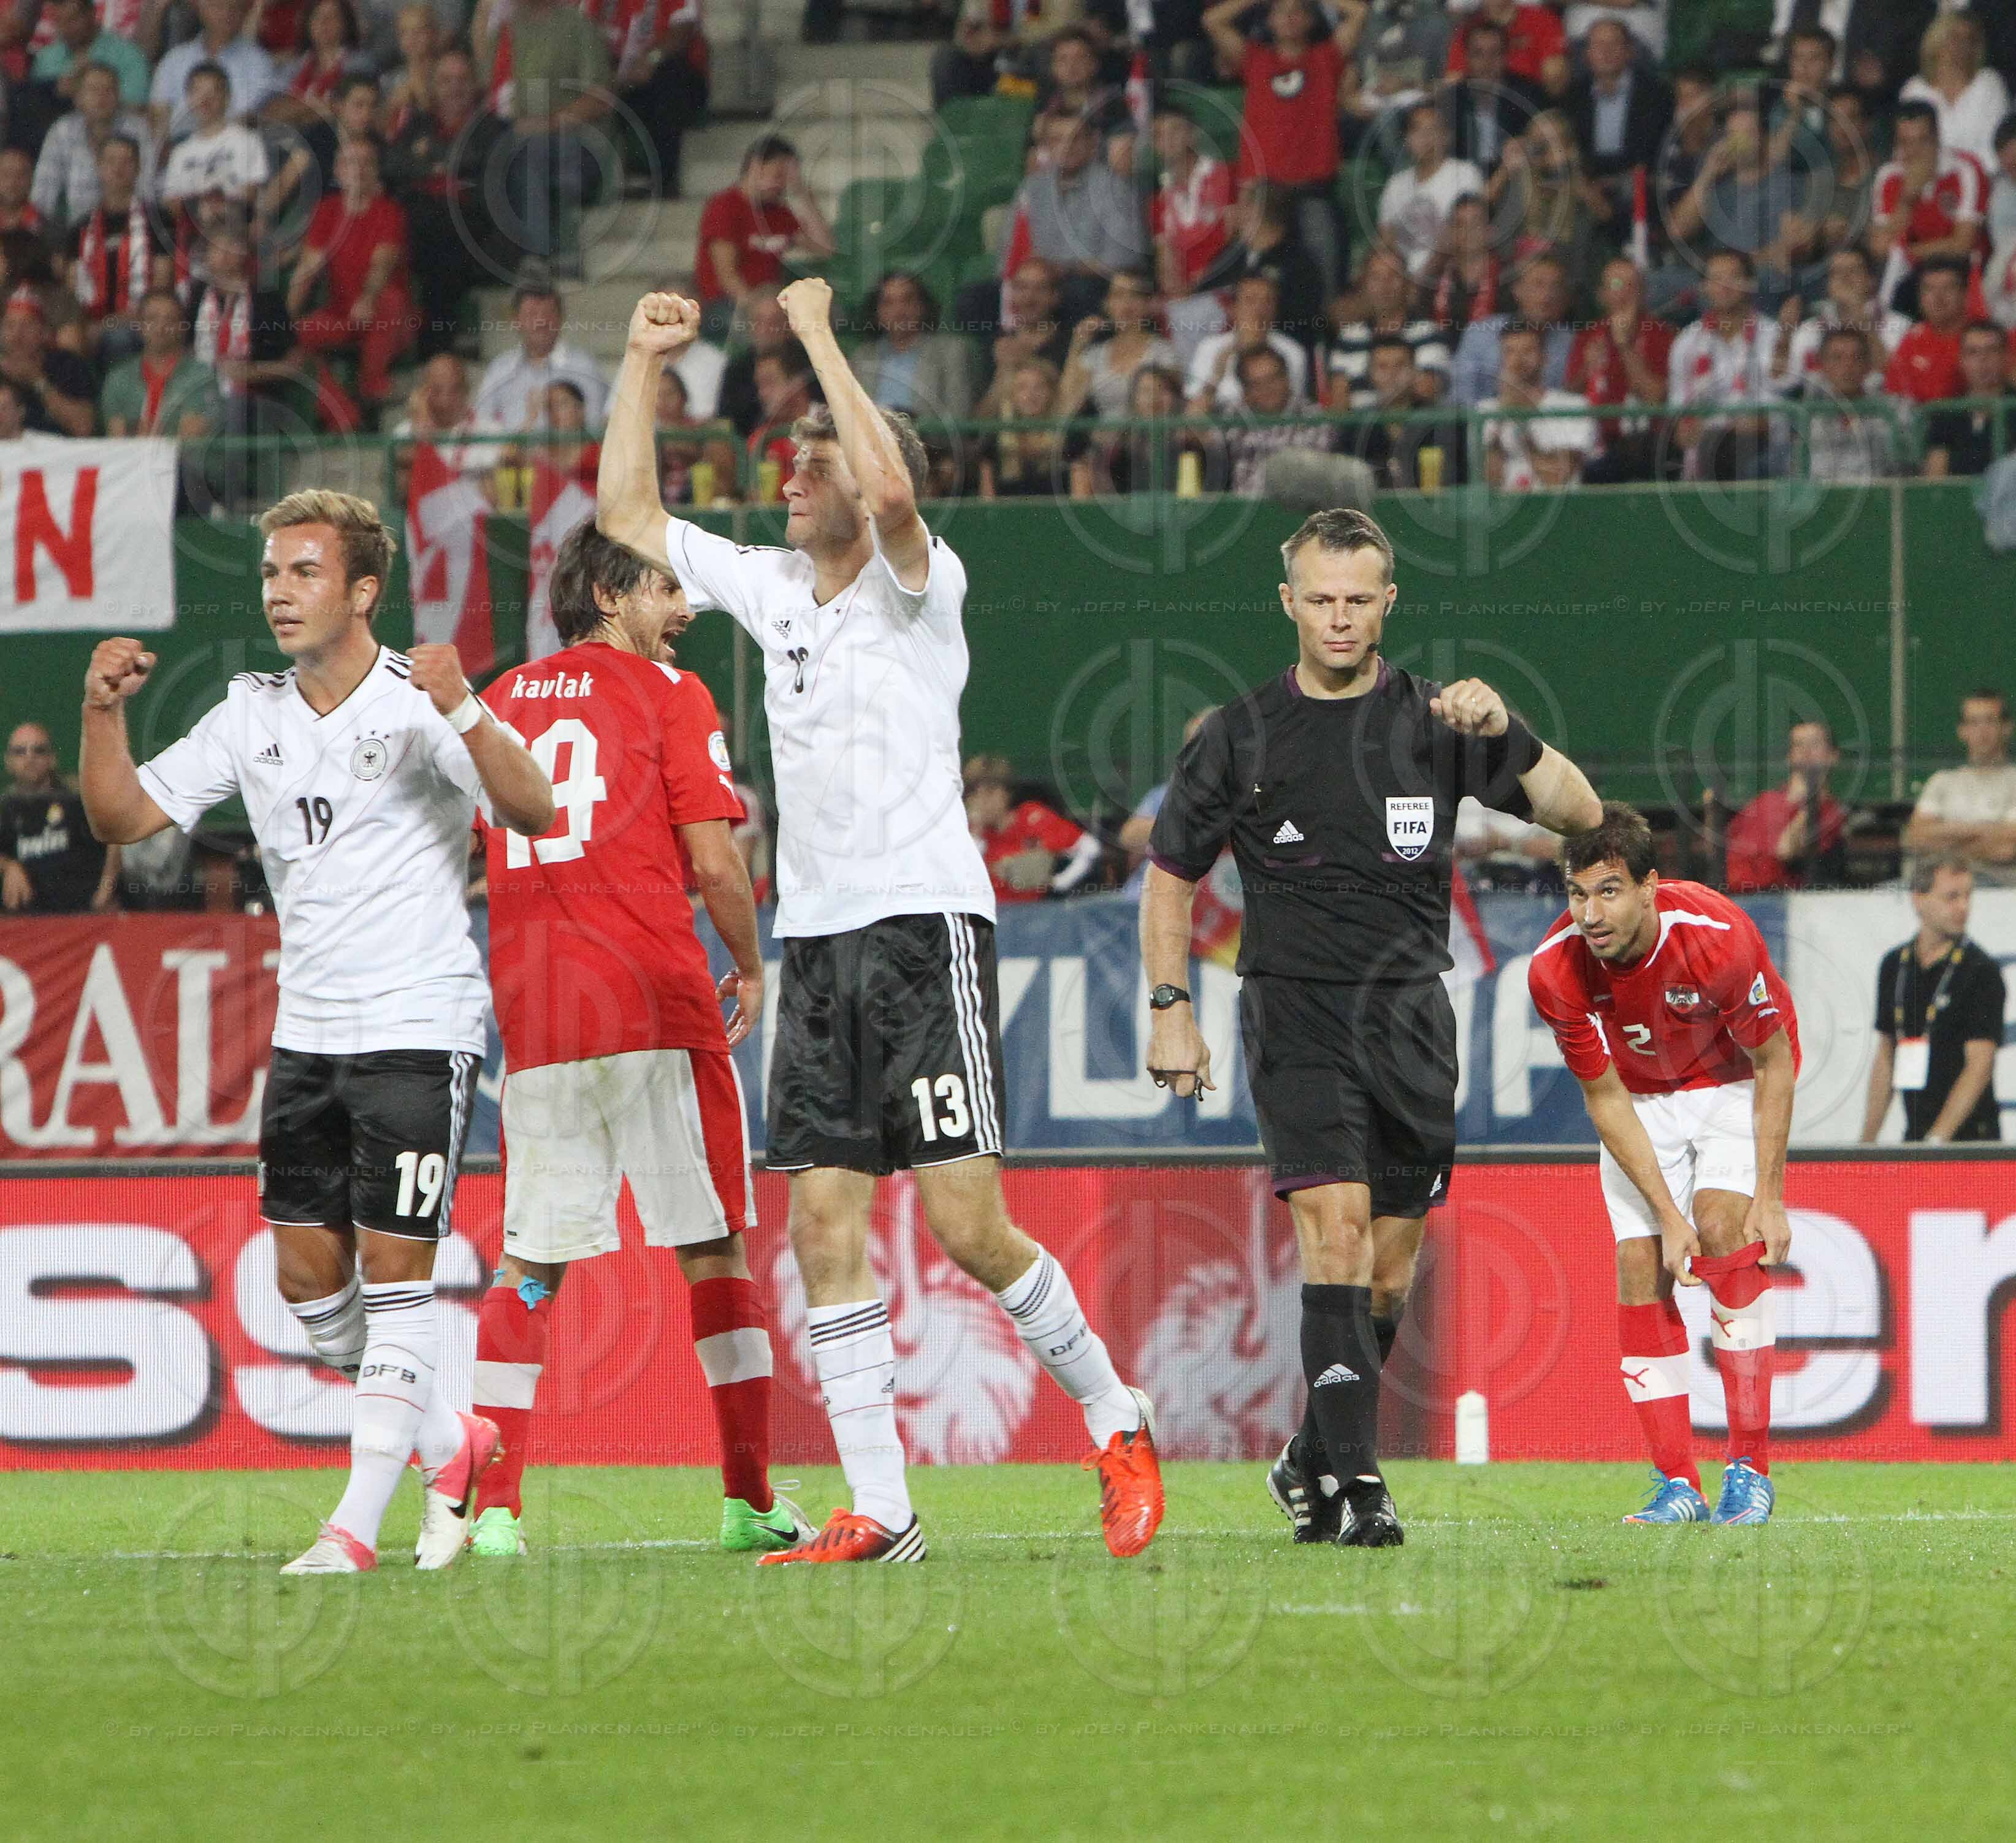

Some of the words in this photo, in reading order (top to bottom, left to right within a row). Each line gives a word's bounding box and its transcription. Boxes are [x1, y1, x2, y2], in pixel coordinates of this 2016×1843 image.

[295, 796, 333, 845] 19
[1394, 822, 1427, 834] FIFA
[1622, 1023, 1657, 1056] 2
[911, 1074, 969, 1142] 13
[395, 1151, 446, 1218] 19
[364, 1364, 416, 1384] DFB
[1313, 1373, 1360, 1387] adidas
